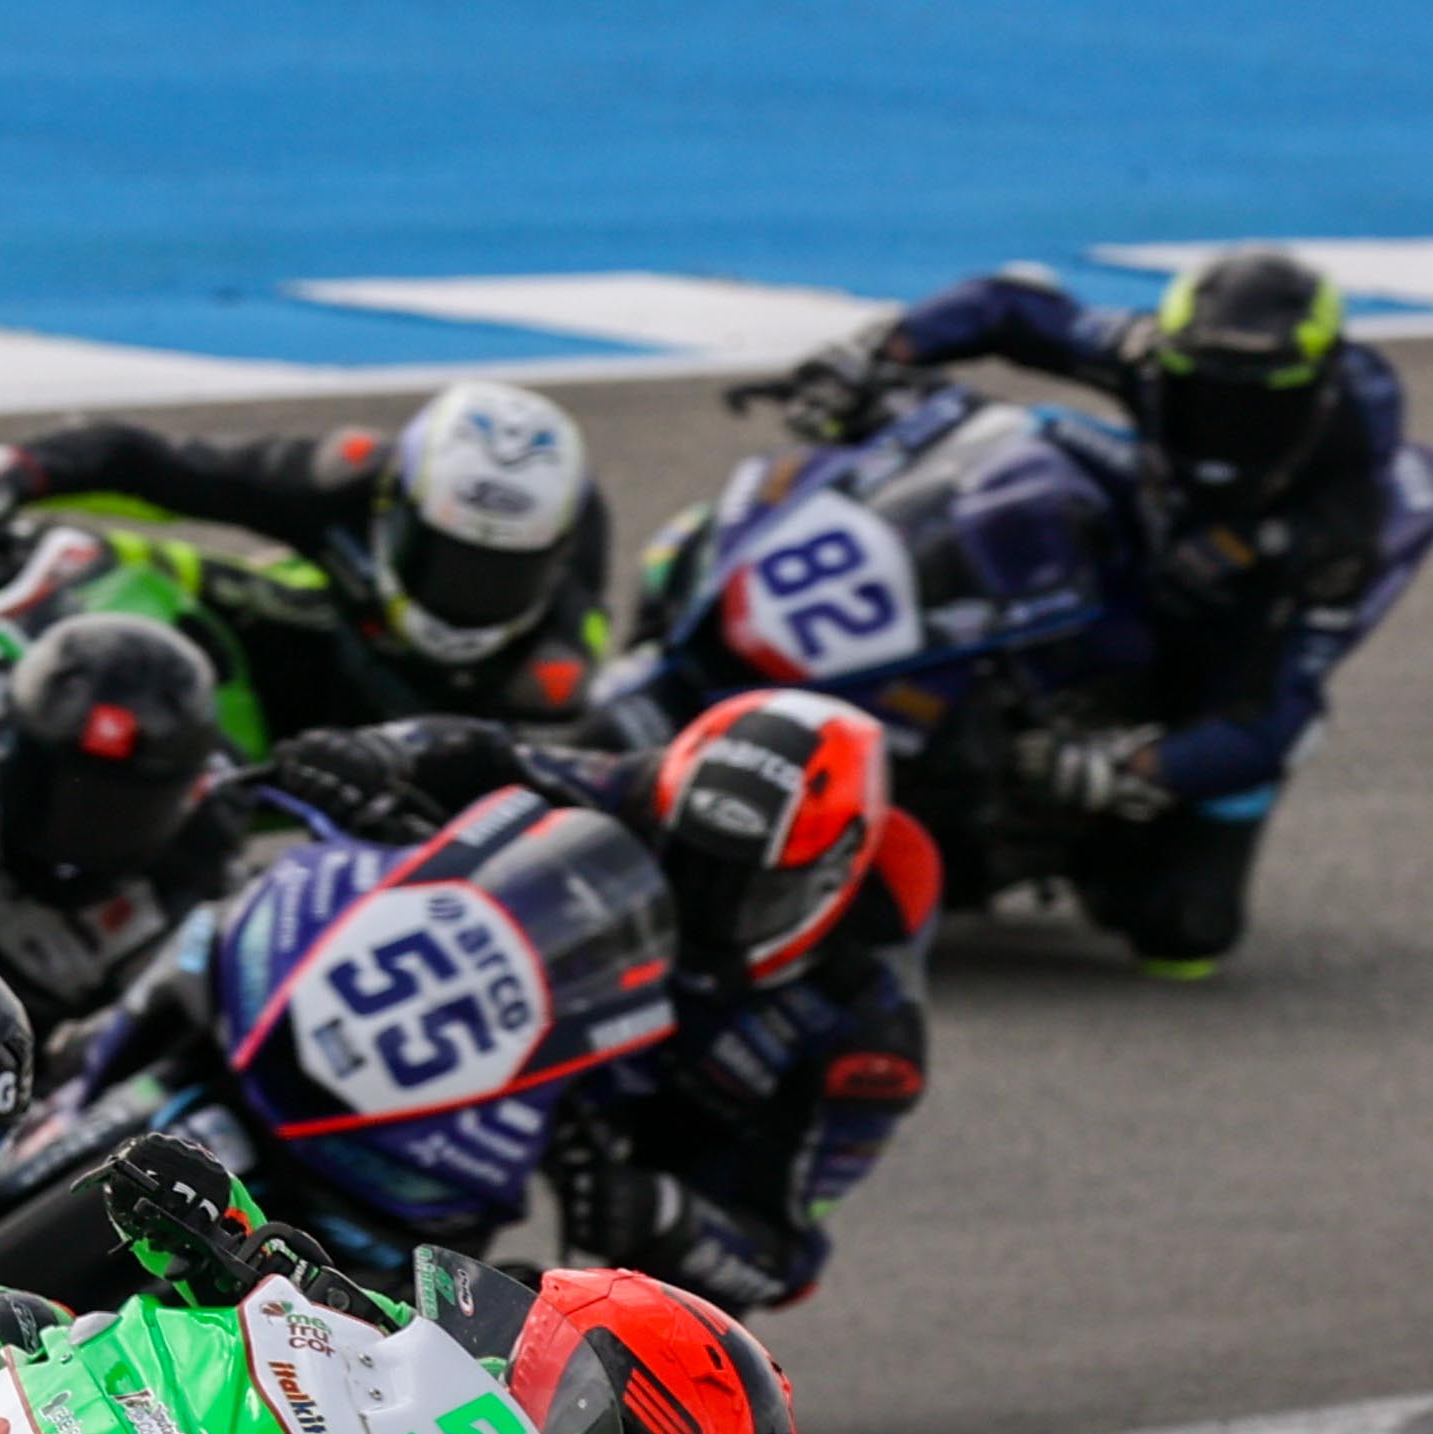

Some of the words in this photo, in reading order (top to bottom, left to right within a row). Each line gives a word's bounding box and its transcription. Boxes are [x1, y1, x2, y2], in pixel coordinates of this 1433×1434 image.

[759, 528, 897, 660] 82
[326, 928, 495, 1090] 55
[453, 914, 529, 1034] arco
